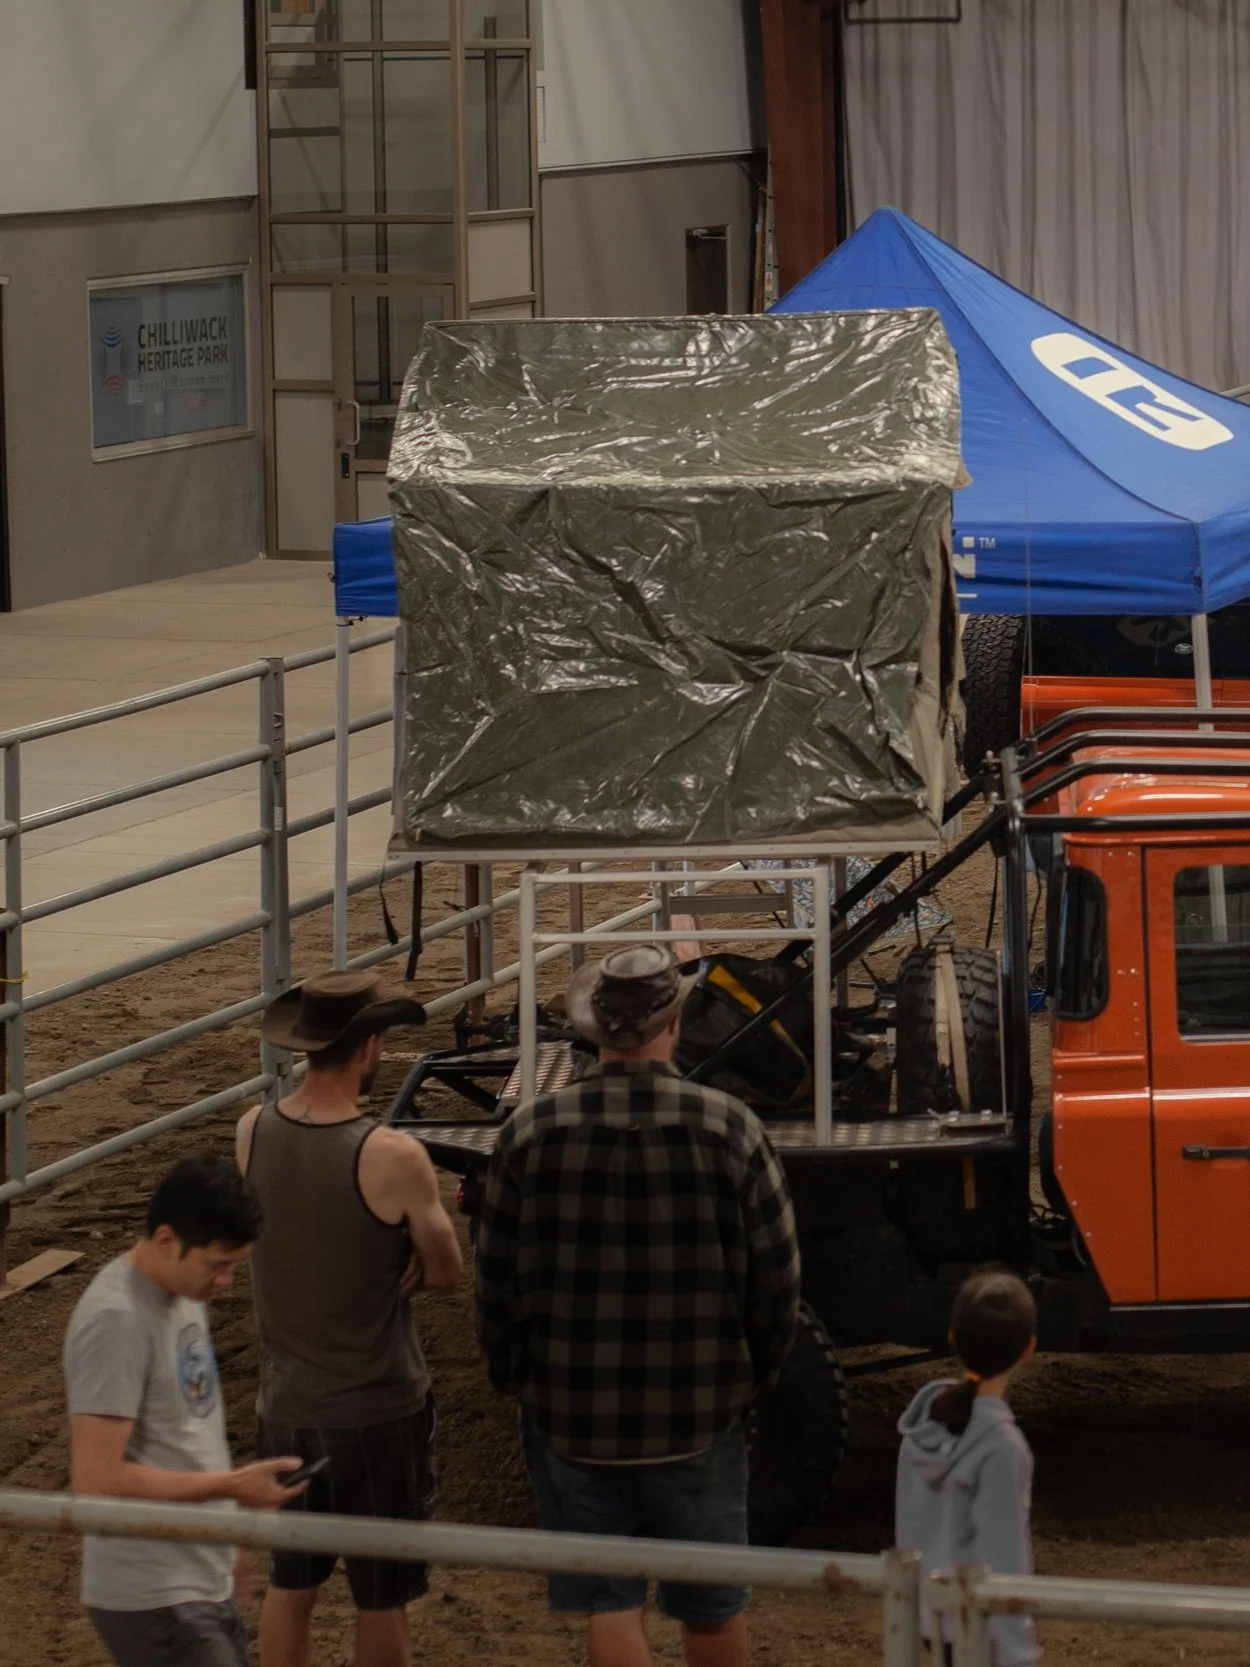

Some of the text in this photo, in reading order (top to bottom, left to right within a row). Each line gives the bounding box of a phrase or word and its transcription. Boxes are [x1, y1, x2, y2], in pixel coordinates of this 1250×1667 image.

[137, 316, 228, 348] CHILLIWACK
[137, 343, 229, 374] HERITAGE PARK
